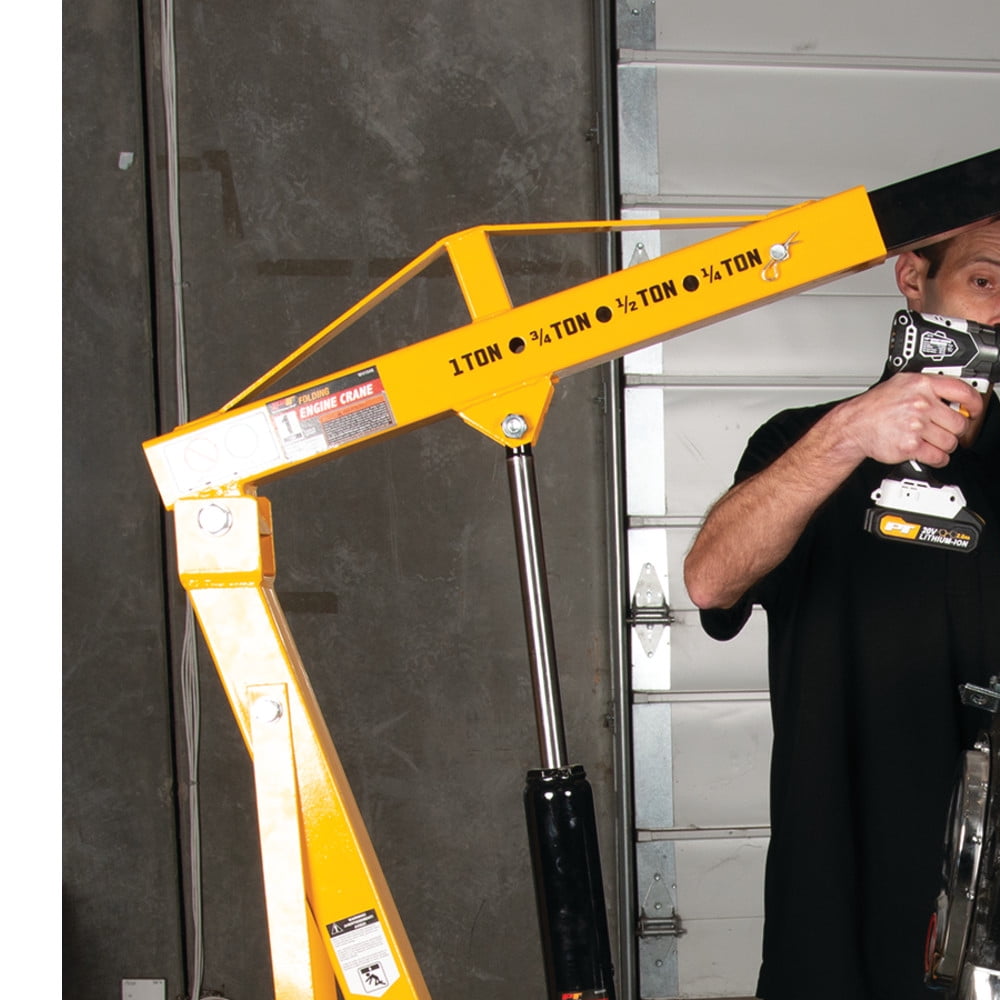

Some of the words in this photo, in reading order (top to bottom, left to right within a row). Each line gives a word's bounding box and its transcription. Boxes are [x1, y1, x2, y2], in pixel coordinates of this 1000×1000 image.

[449, 359, 464, 376] 1
[461, 343, 503, 371] TON
[549, 312, 592, 340] TON
[636, 280, 678, 308] TON
[720, 248, 763, 276] TON
[298, 387, 330, 404] FOLDING
[299, 399, 338, 419] ENGINE
[340, 384, 374, 404] CRANE
[919, 532, 969, 547] LITHIUM-ION
